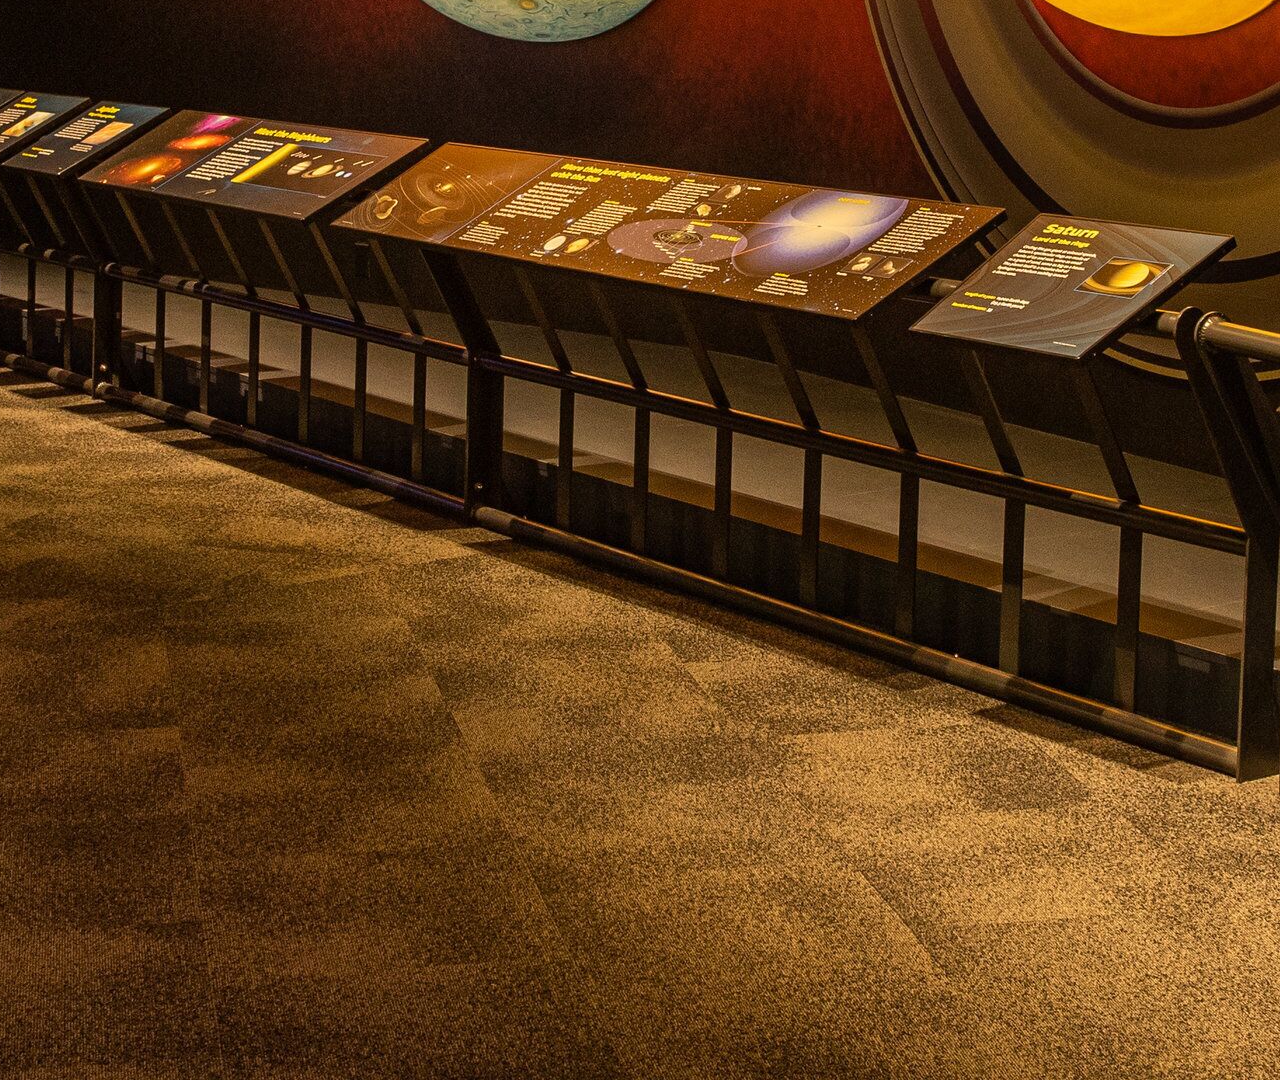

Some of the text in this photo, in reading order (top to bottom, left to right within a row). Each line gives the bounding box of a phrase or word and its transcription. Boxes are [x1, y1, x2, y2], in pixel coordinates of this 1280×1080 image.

[254, 128, 332, 143] Meet the Neighbours
[561, 163, 671, 183] More than just eight planets
[583, 175, 601, 183] Sun
[1043, 224, 1099, 238] Saturn
